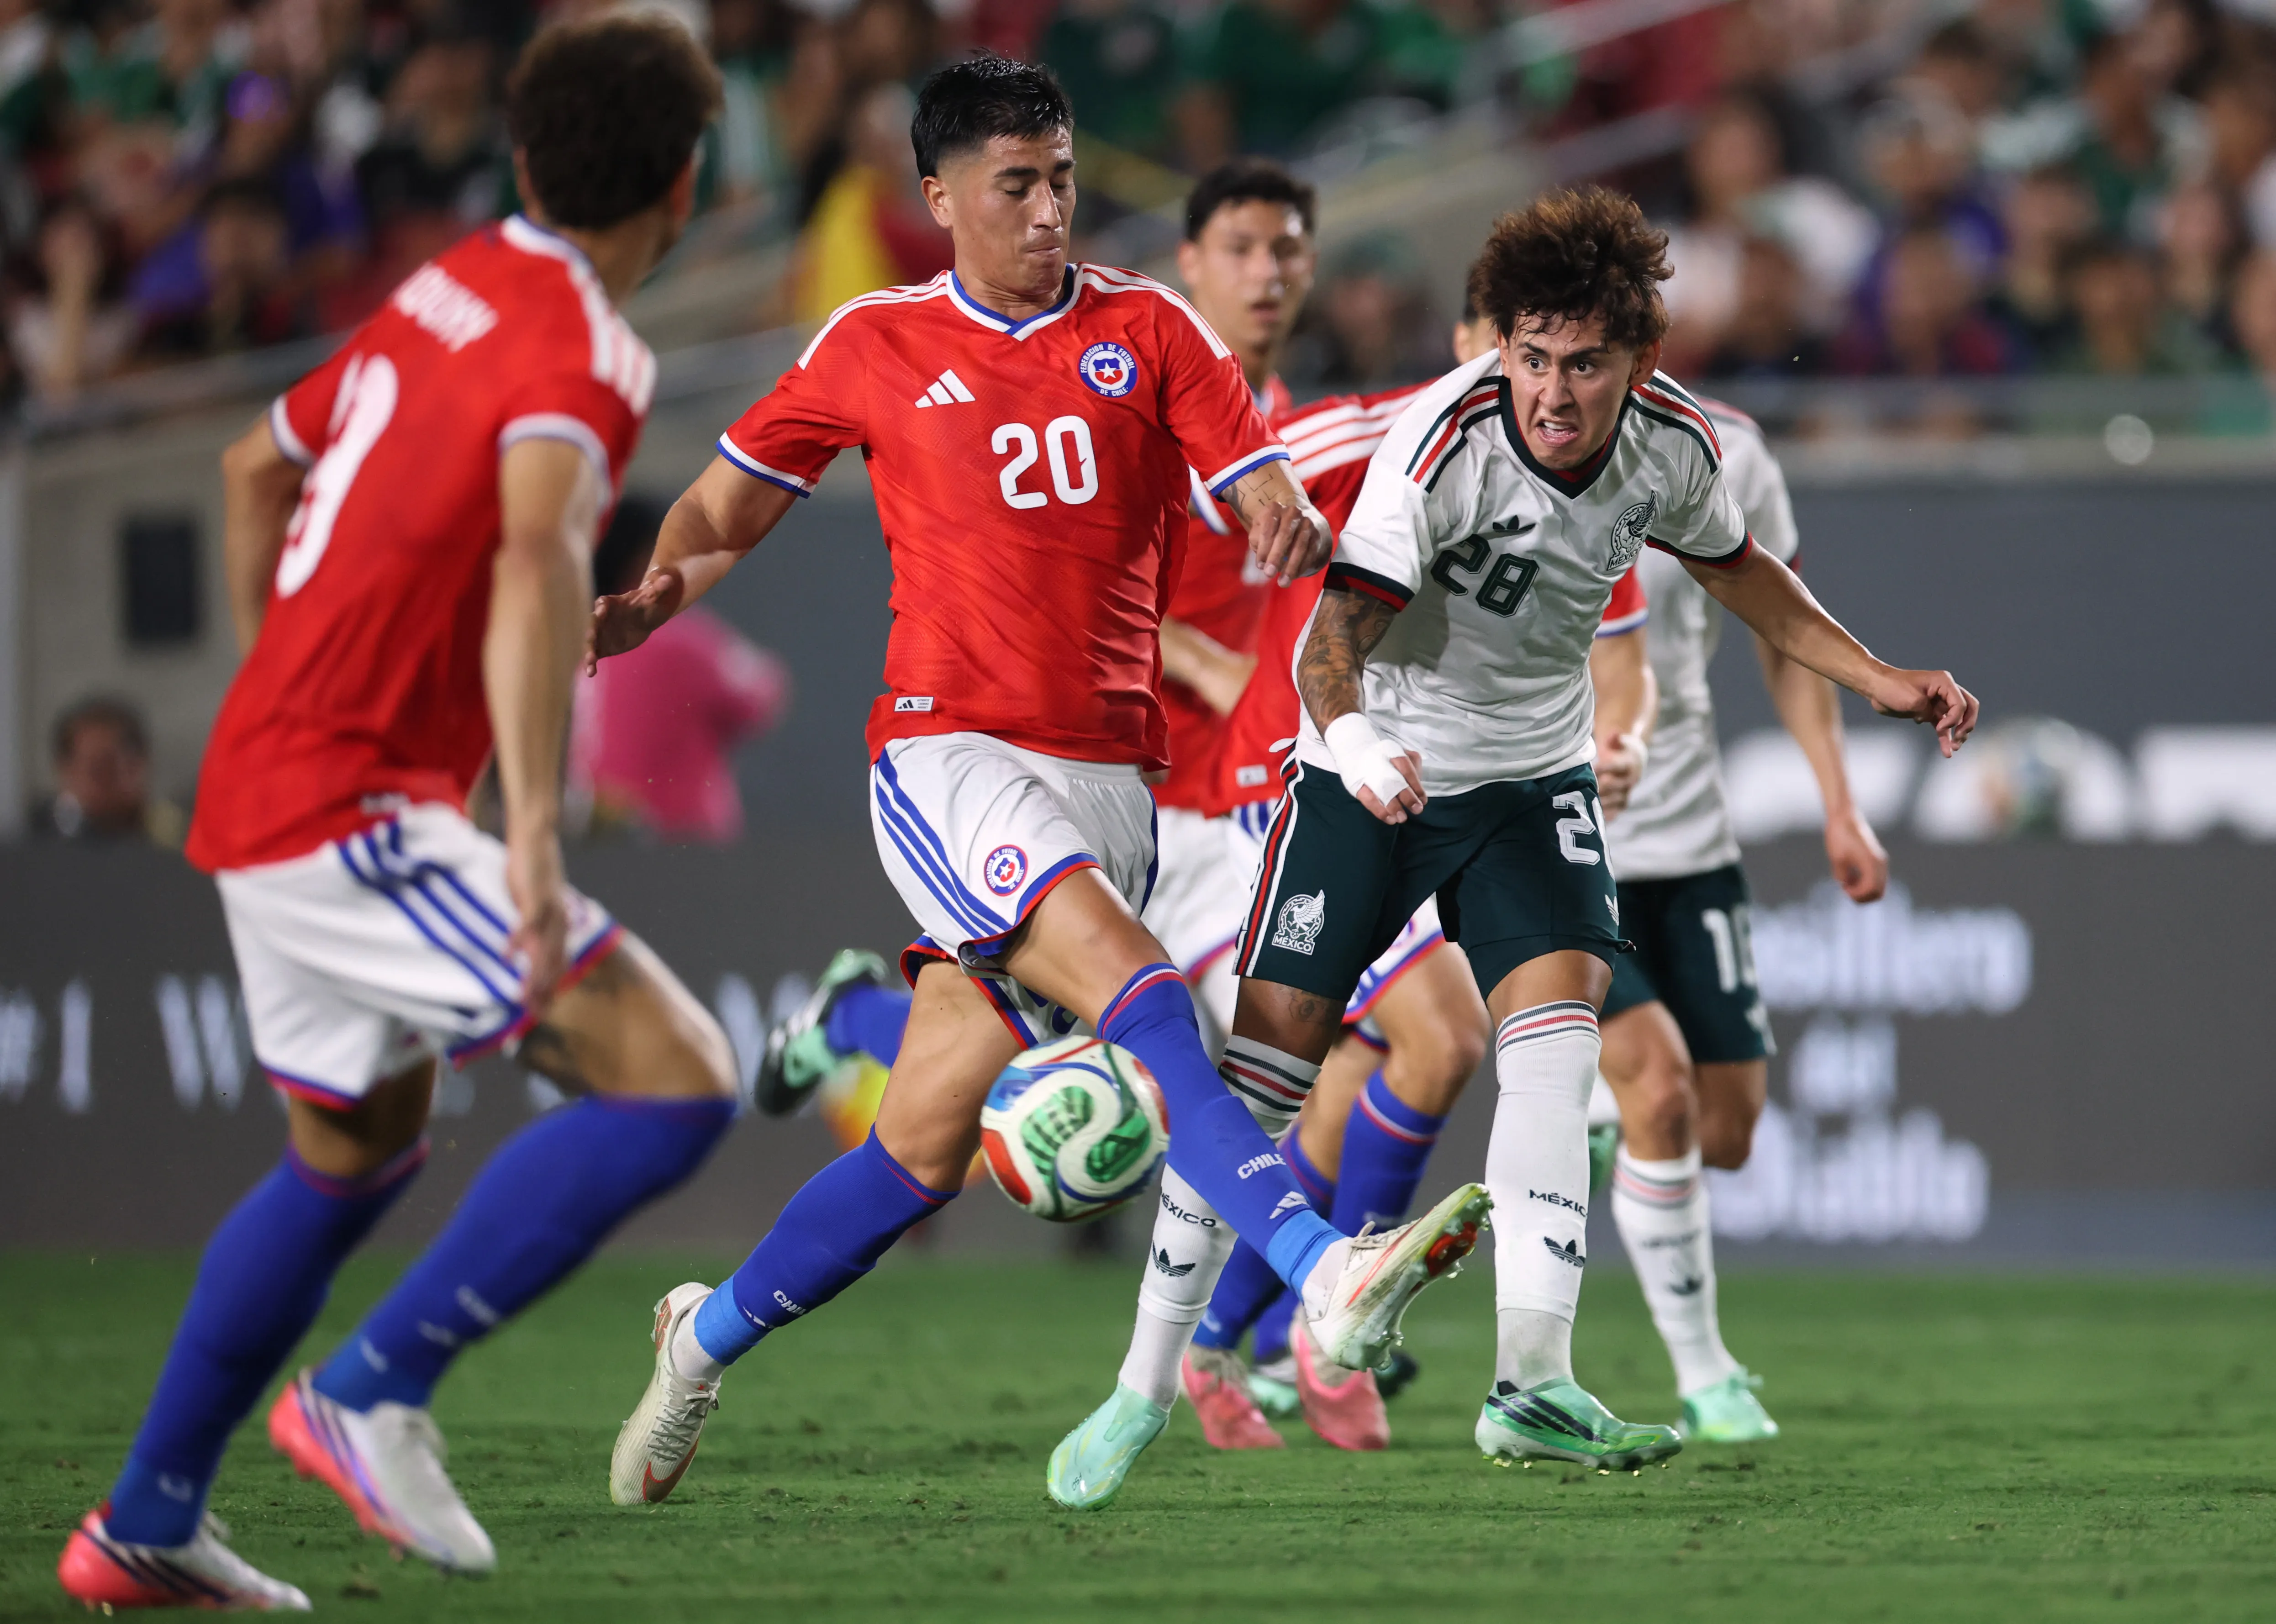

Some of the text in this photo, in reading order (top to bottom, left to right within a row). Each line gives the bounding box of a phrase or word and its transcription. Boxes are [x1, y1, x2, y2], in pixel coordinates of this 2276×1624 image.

[1080, 344, 1104, 374] FEDERACION
[1118, 348, 1135, 370] FUTBOL
[1112, 387, 1128, 396] CHILE
[991, 415, 1098, 509] 20
[1430, 533, 1540, 618] 28
[1274, 935, 1312, 952] MÉXICO
[1161, 1192, 1216, 1228] ÉXICO
[1529, 1189, 1588, 1218] MÉXIC
